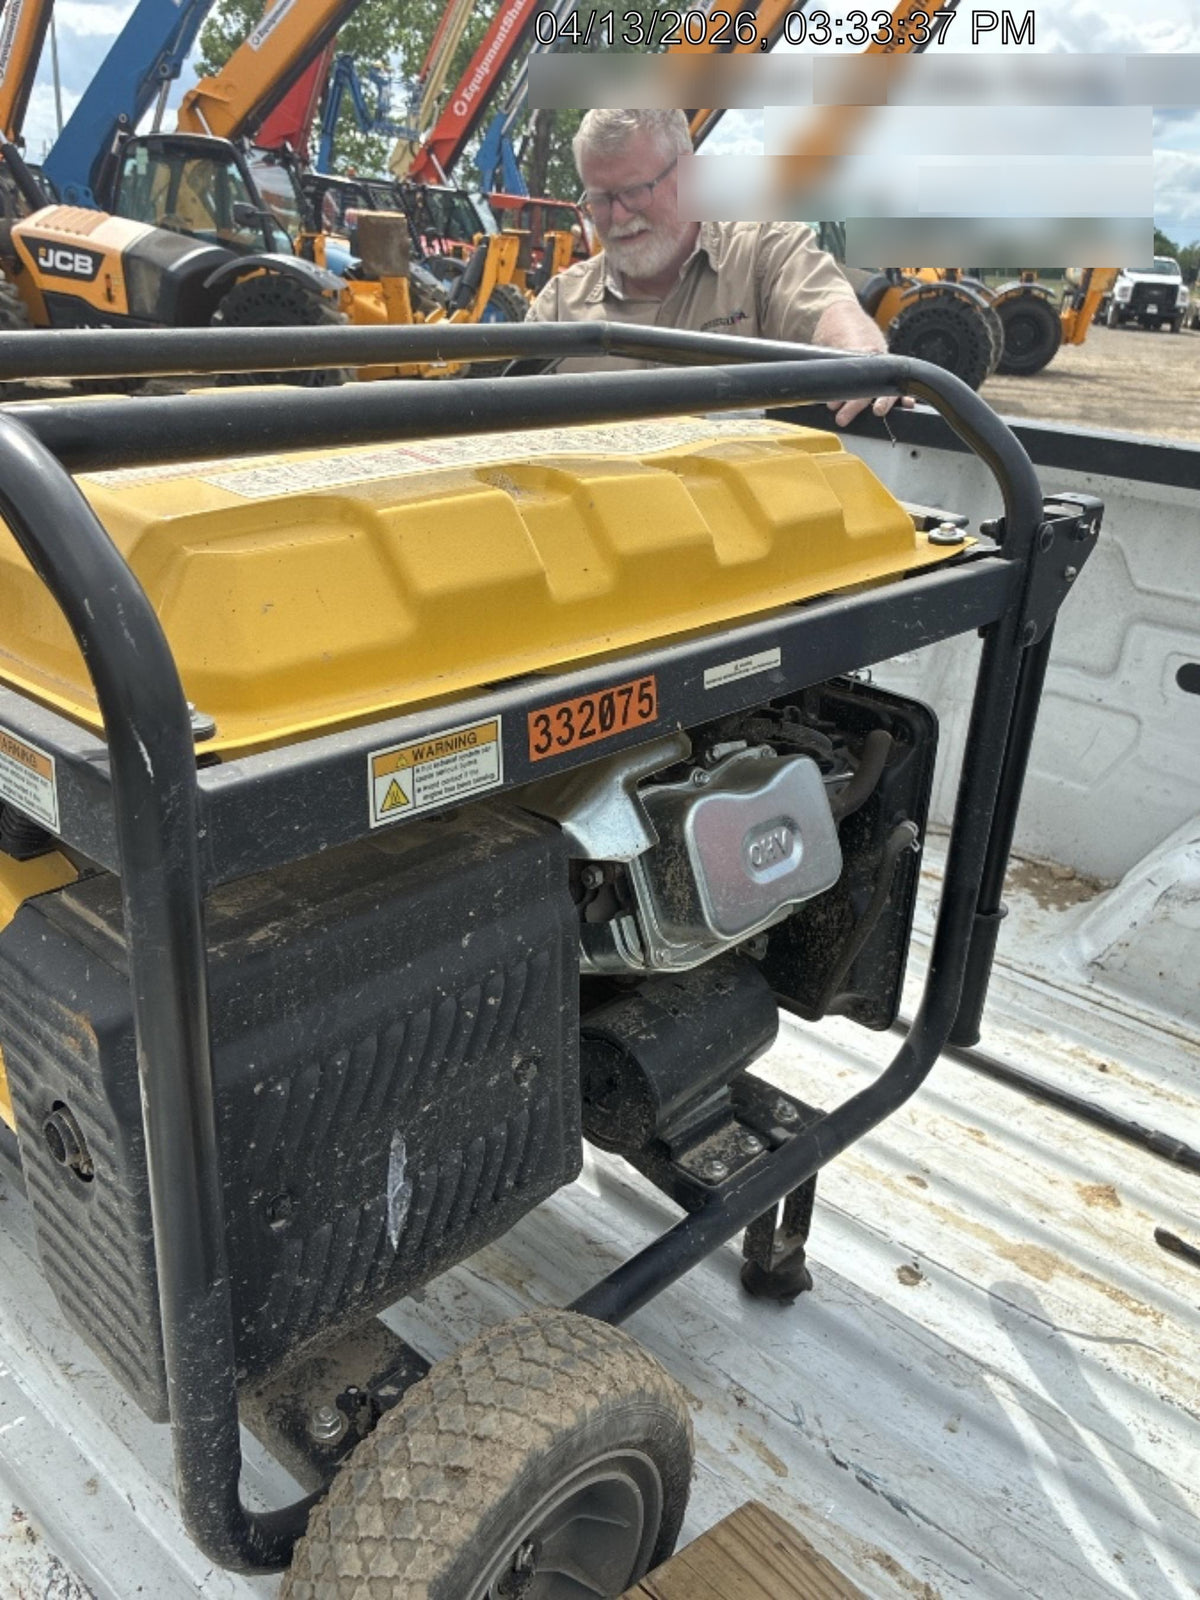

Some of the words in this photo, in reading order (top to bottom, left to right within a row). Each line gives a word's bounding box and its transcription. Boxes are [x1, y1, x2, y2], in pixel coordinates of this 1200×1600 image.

[38, 247, 94, 275] JCB
[533, 680, 654, 754] 332075
[412, 731, 478, 762] WARNING
